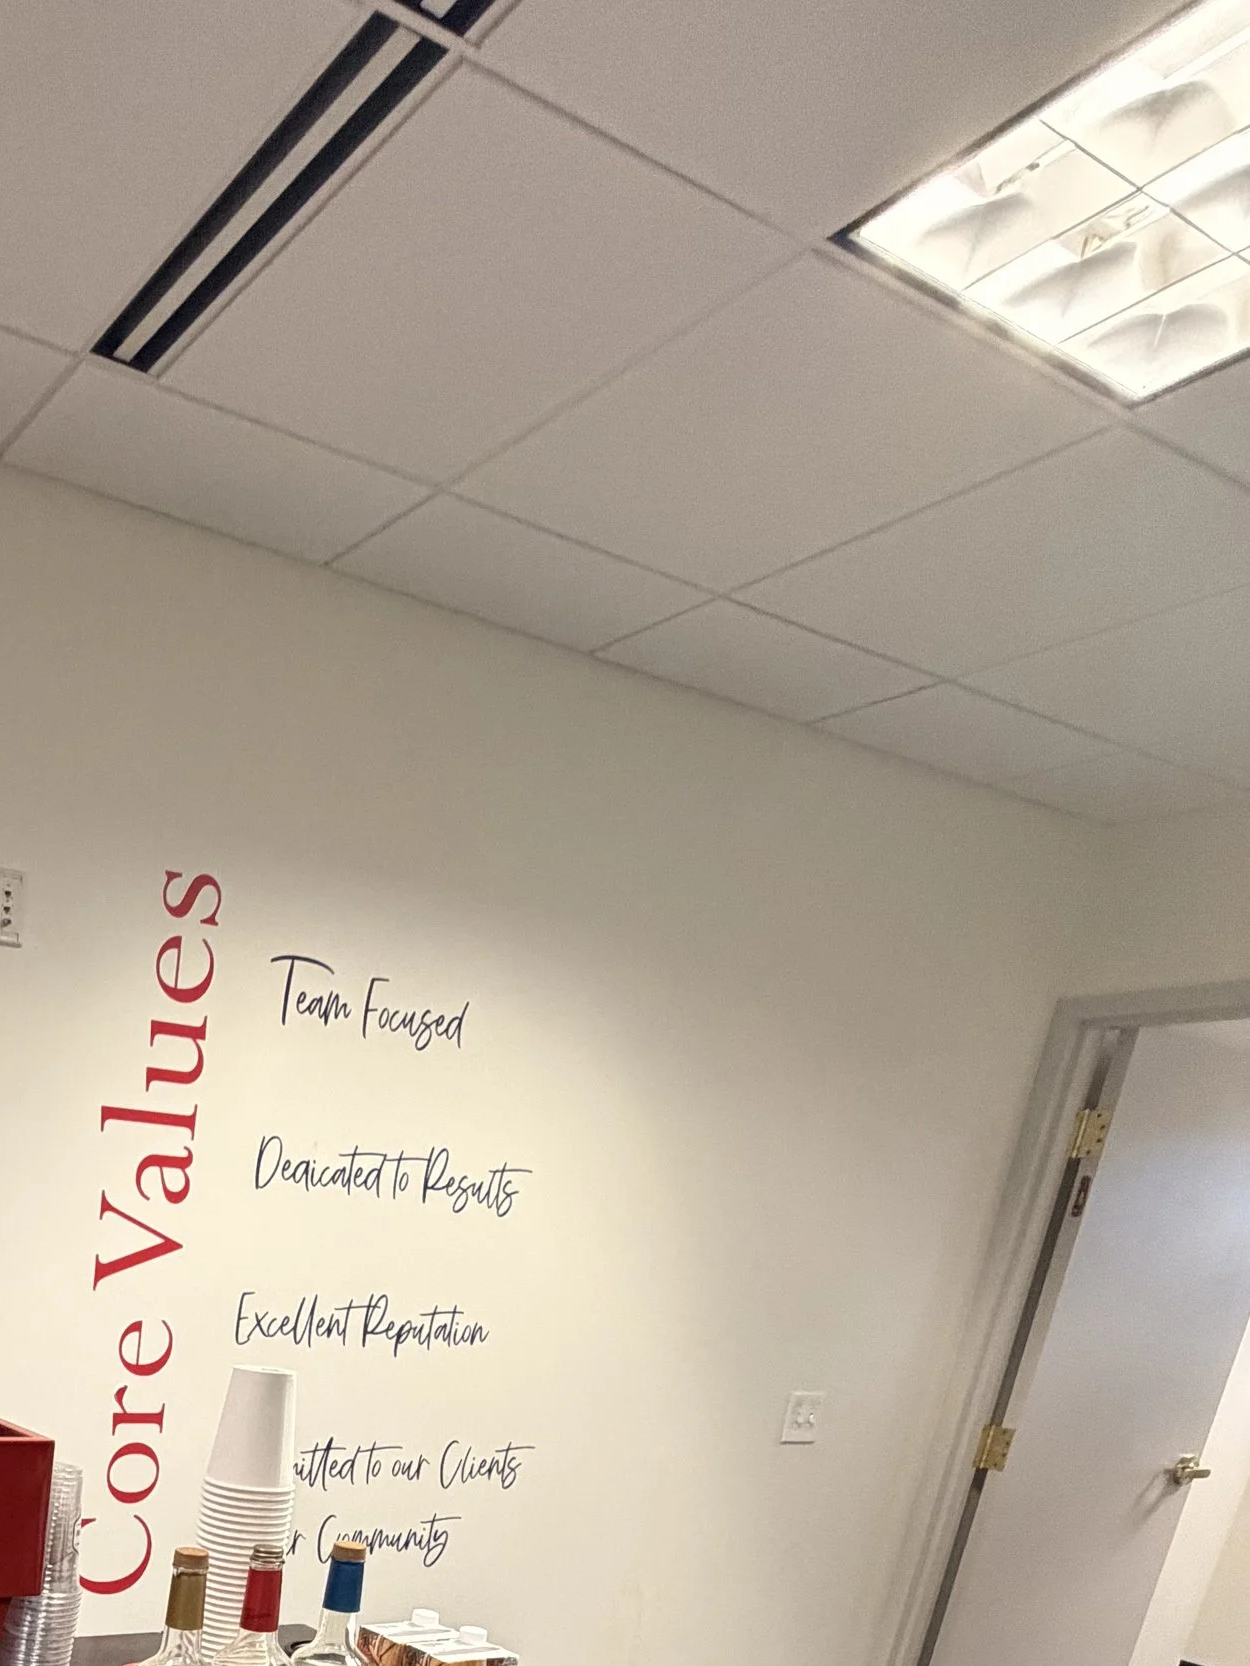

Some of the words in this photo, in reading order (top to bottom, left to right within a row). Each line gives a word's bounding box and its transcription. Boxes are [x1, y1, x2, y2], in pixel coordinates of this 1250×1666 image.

[270, 955, 352, 1027] Team
[362, 977, 470, 1051] Focused
[93, 869, 222, 1291] Values
[254, 1135, 387, 1198] Dedicated
[383, 1150, 428, 1200] to
[422, 1146, 533, 1217] Results
[235, 1291, 364, 1348] Excellent
[361, 1293, 490, 1358] Reputation
[79, 1319, 173, 1595] Core
[359, 1441, 403, 1485] to
[391, 1454, 430, 1481] our
[440, 1440, 536, 1490] Clients
